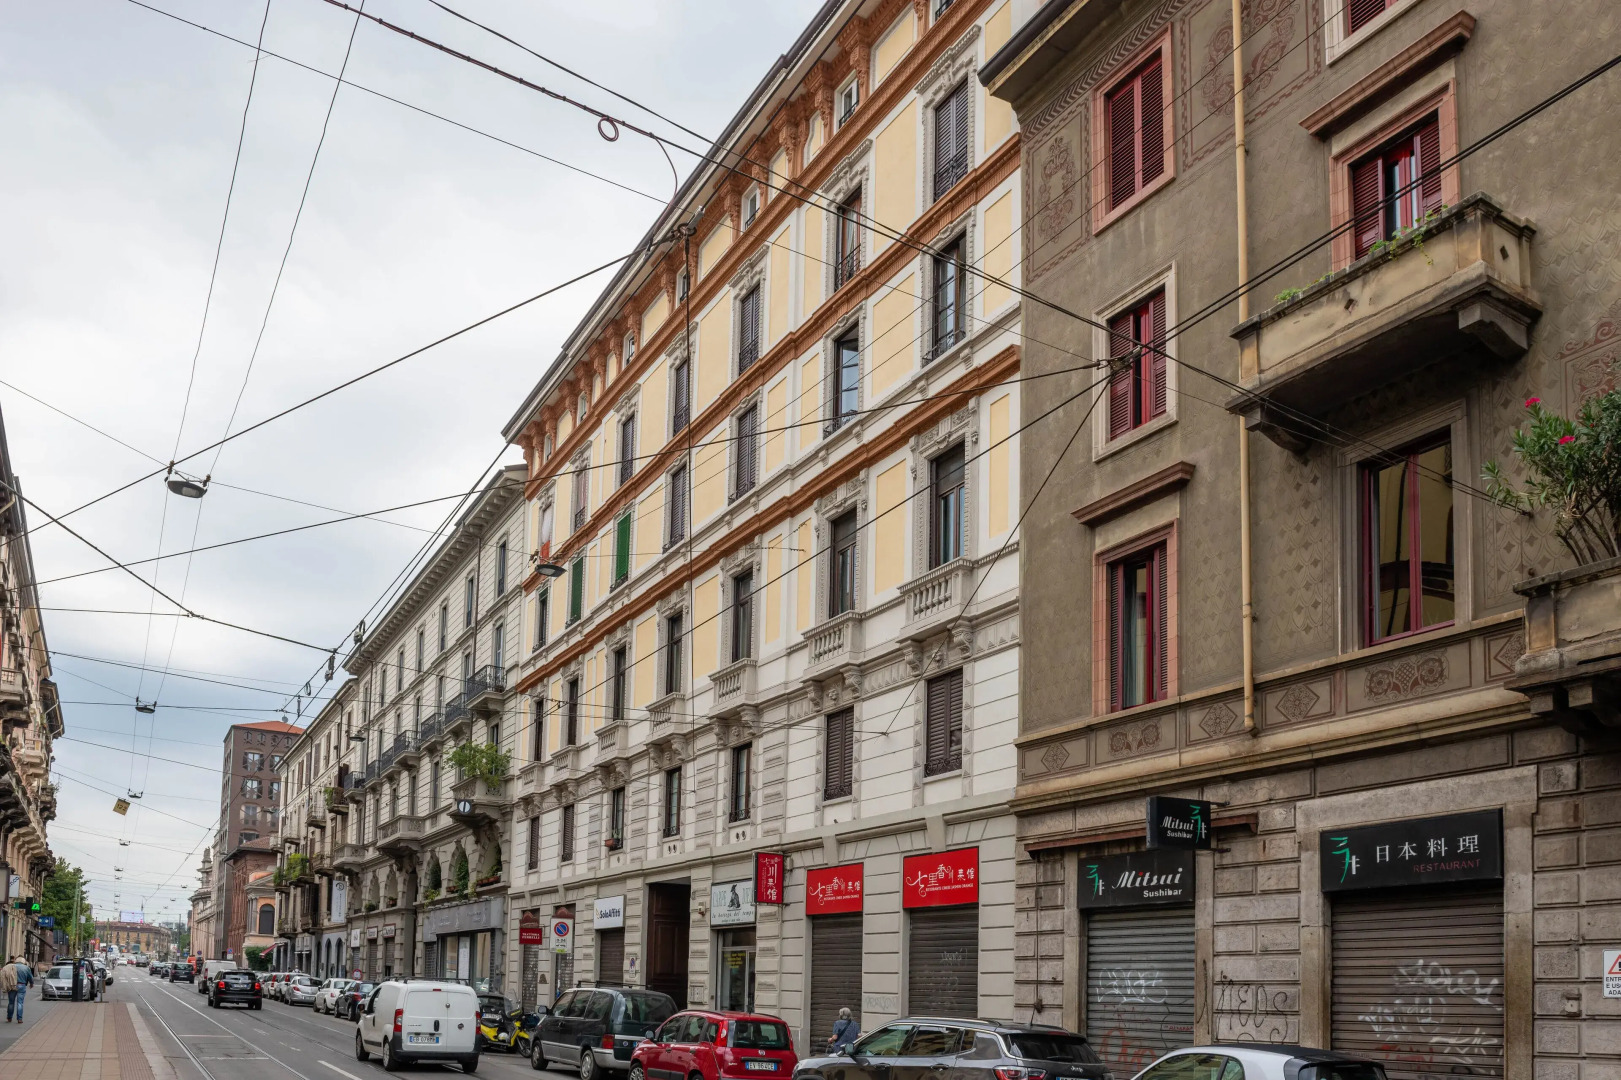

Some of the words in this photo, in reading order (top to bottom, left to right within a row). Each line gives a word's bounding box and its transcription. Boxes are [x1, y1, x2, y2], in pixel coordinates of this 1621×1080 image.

[1160, 816, 1195, 831] Mitsui
[1167, 830, 1193, 839] Sushibar
[1376, 834, 1480, 863] 日本料理
[1413, 859, 1480, 873] RESTAURANT
[1111, 867, 1183, 889] Mitsui
[1143, 888, 1183, 898] Sushibar
